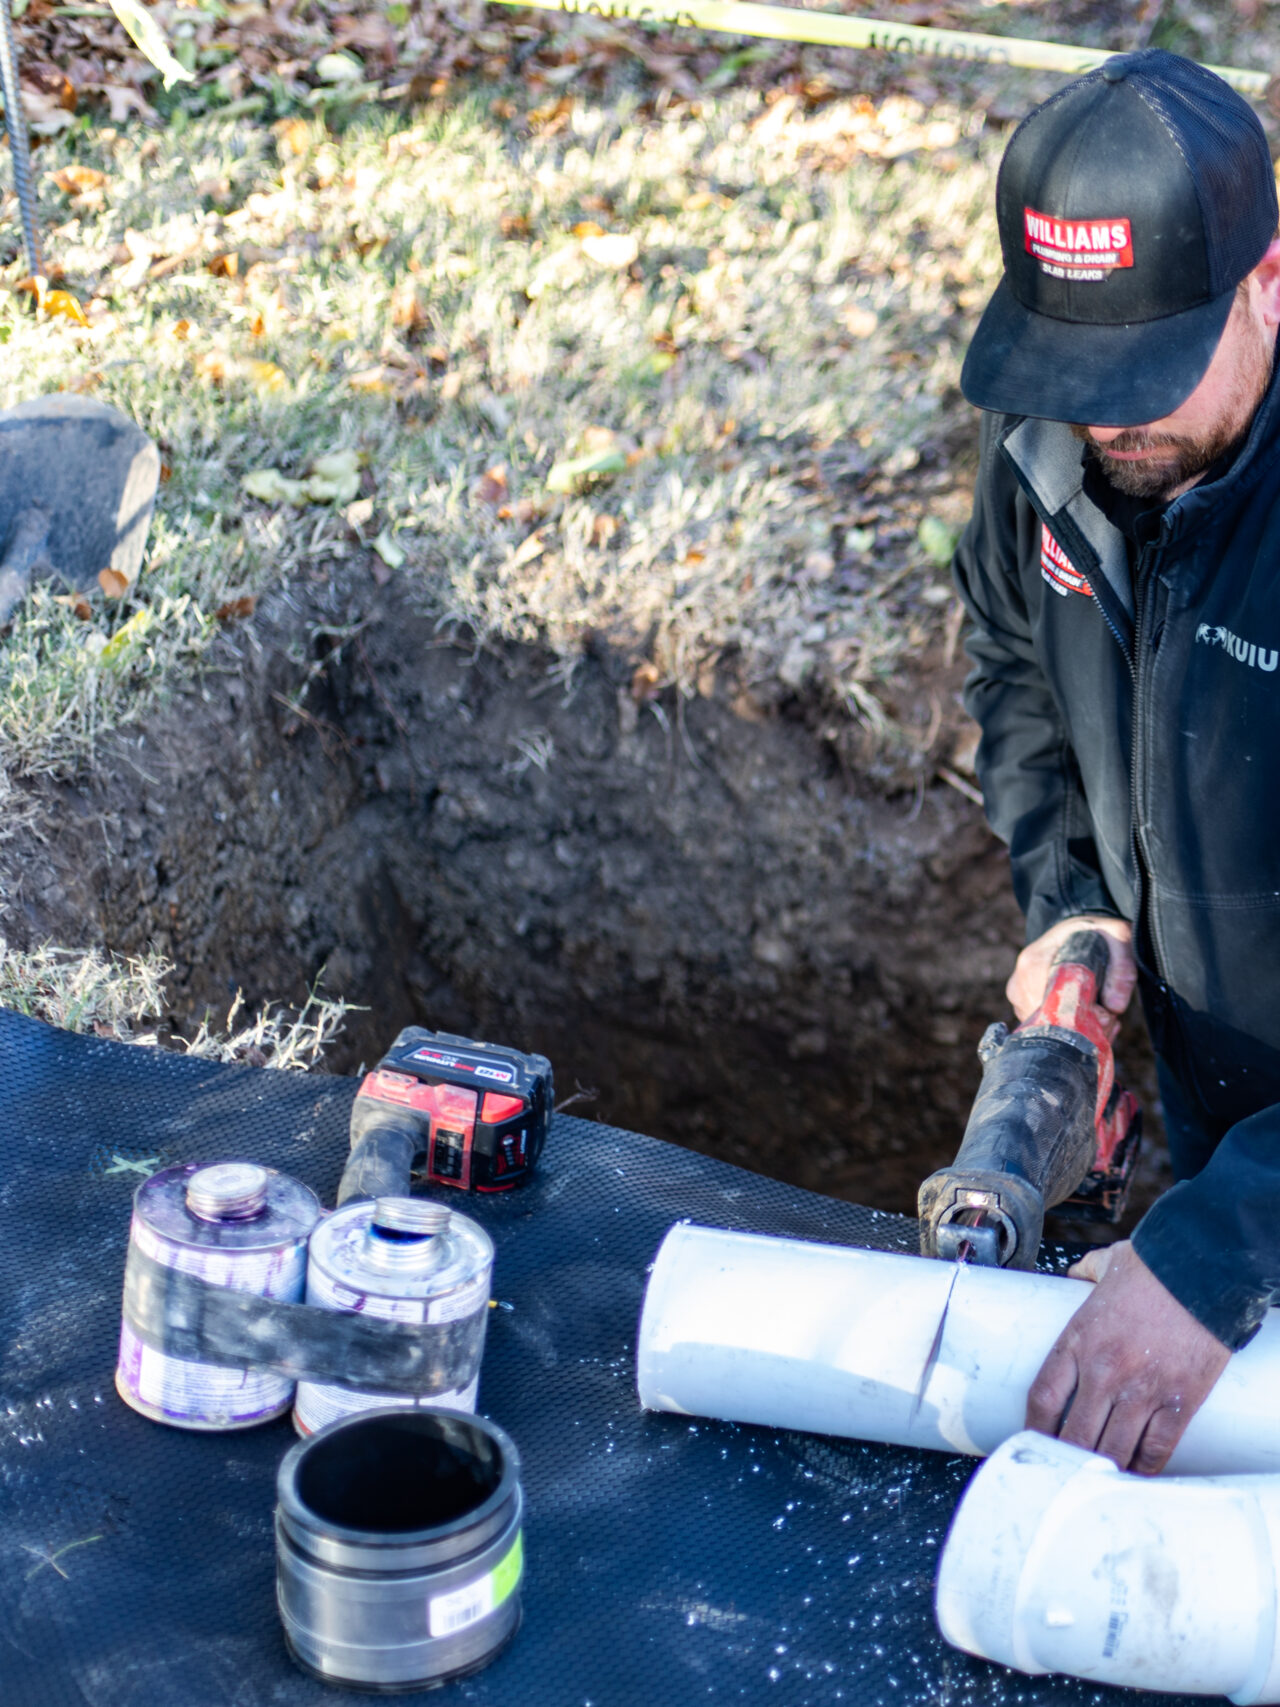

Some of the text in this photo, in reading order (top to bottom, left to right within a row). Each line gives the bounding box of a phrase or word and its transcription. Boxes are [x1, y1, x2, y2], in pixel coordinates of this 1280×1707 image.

[1026, 213, 1127, 250] WILLIAMS
[1067, 267, 1103, 280] LEAKS
[1226, 630, 1279, 672] KUIU
